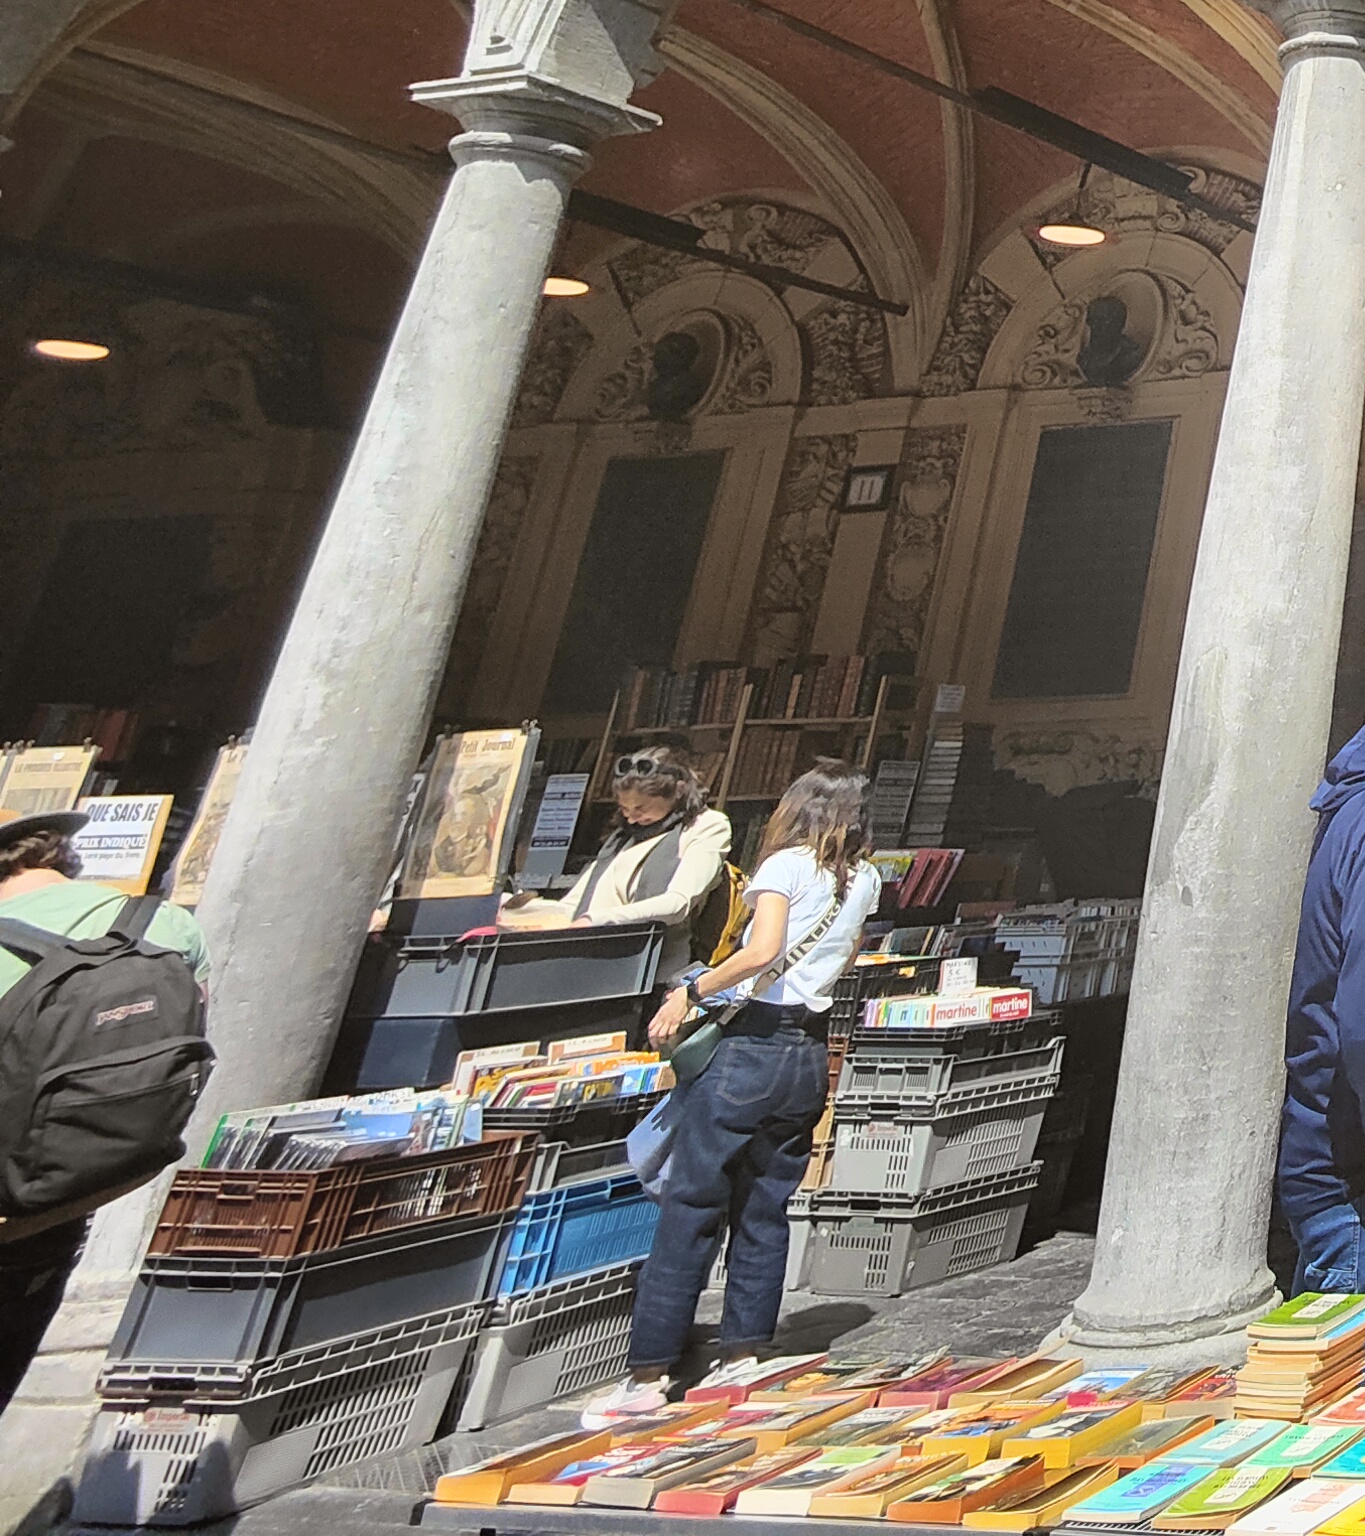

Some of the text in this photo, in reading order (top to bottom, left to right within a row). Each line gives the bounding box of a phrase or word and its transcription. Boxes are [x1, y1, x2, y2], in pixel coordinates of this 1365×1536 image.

[482, 737, 517, 752] Journal
[87, 802, 158, 823] QUE SAIS JE
[936, 1002, 978, 1020] martine
[993, 996, 1028, 1014] martine
